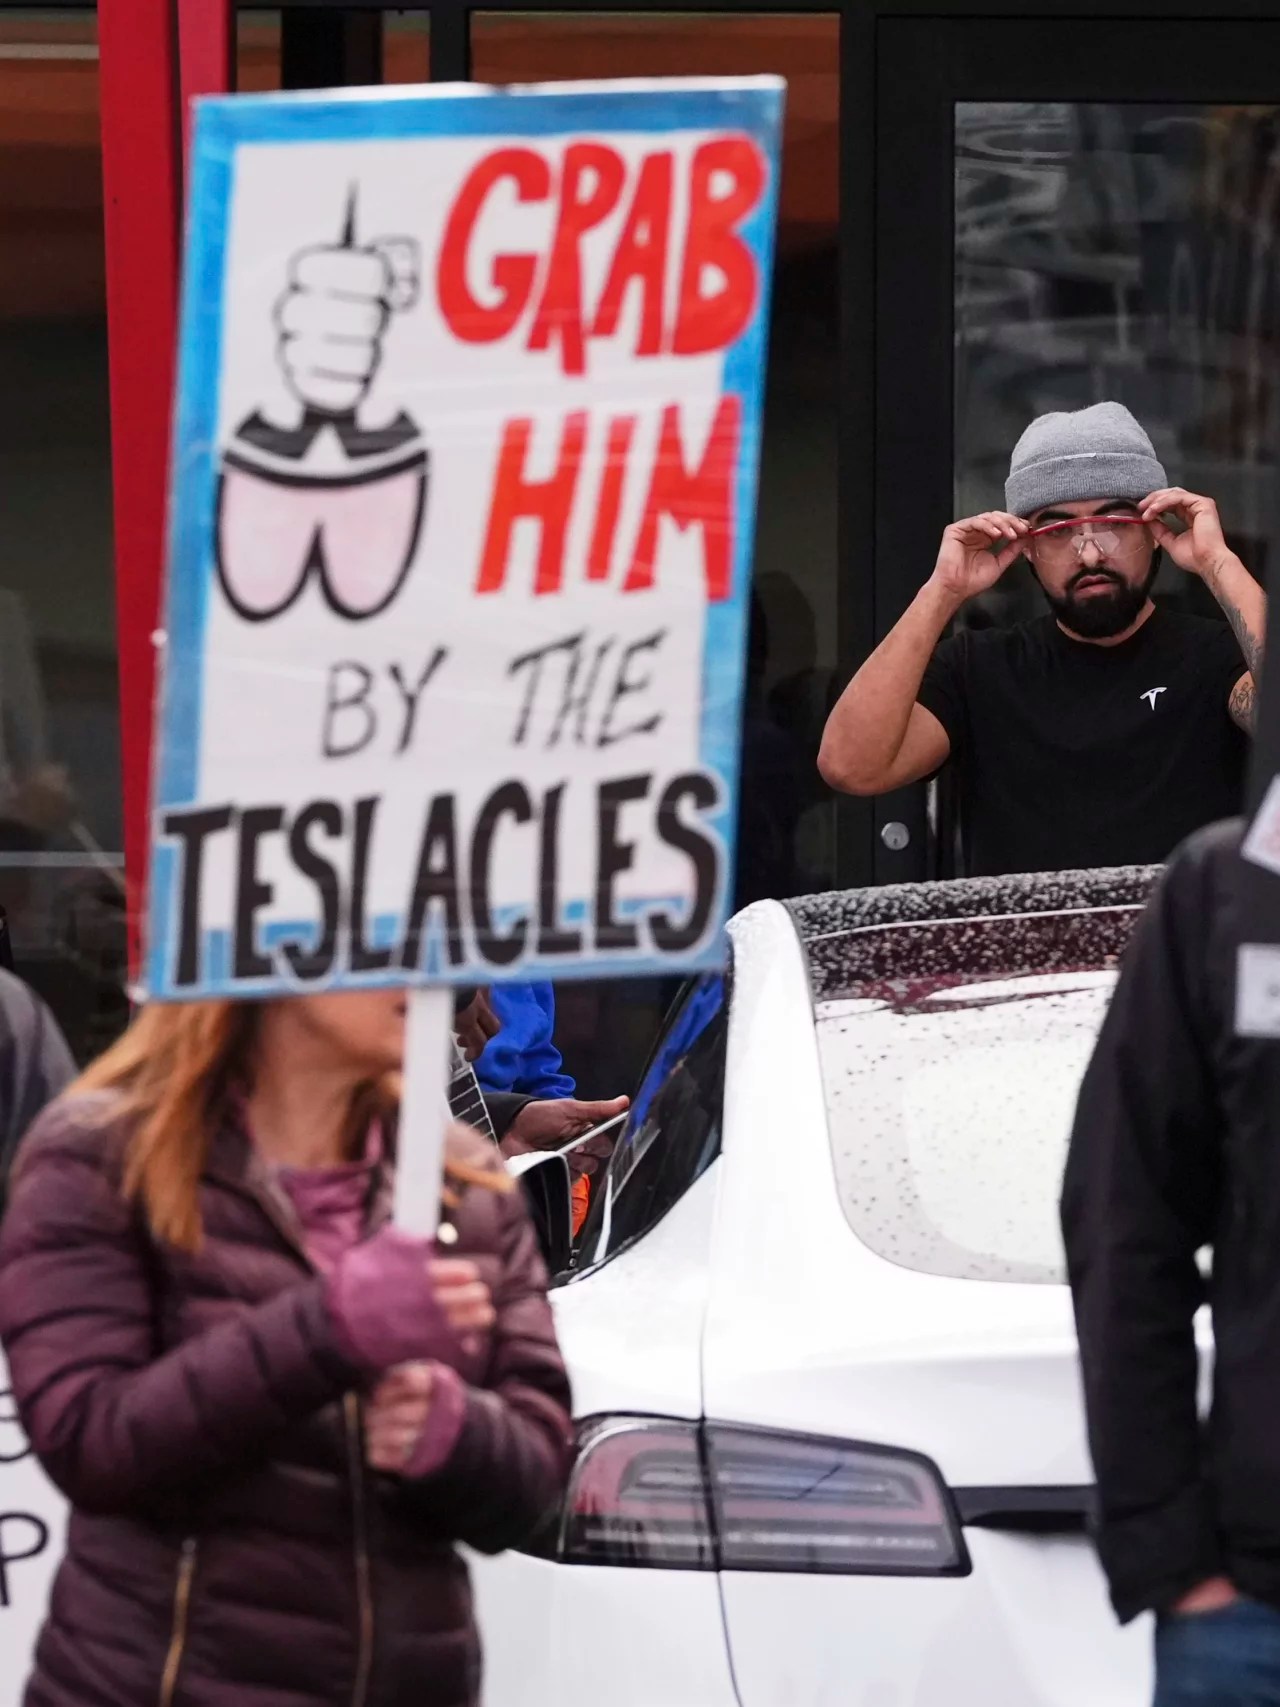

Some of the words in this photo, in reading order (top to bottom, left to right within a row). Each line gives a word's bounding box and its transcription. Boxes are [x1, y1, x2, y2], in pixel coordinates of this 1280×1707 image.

[437, 131, 766, 376] GRAB
[475, 394, 741, 602] HIM
[320, 647, 448, 760] BY
[508, 626, 669, 750] THE
[163, 772, 722, 986] TESLACLES
